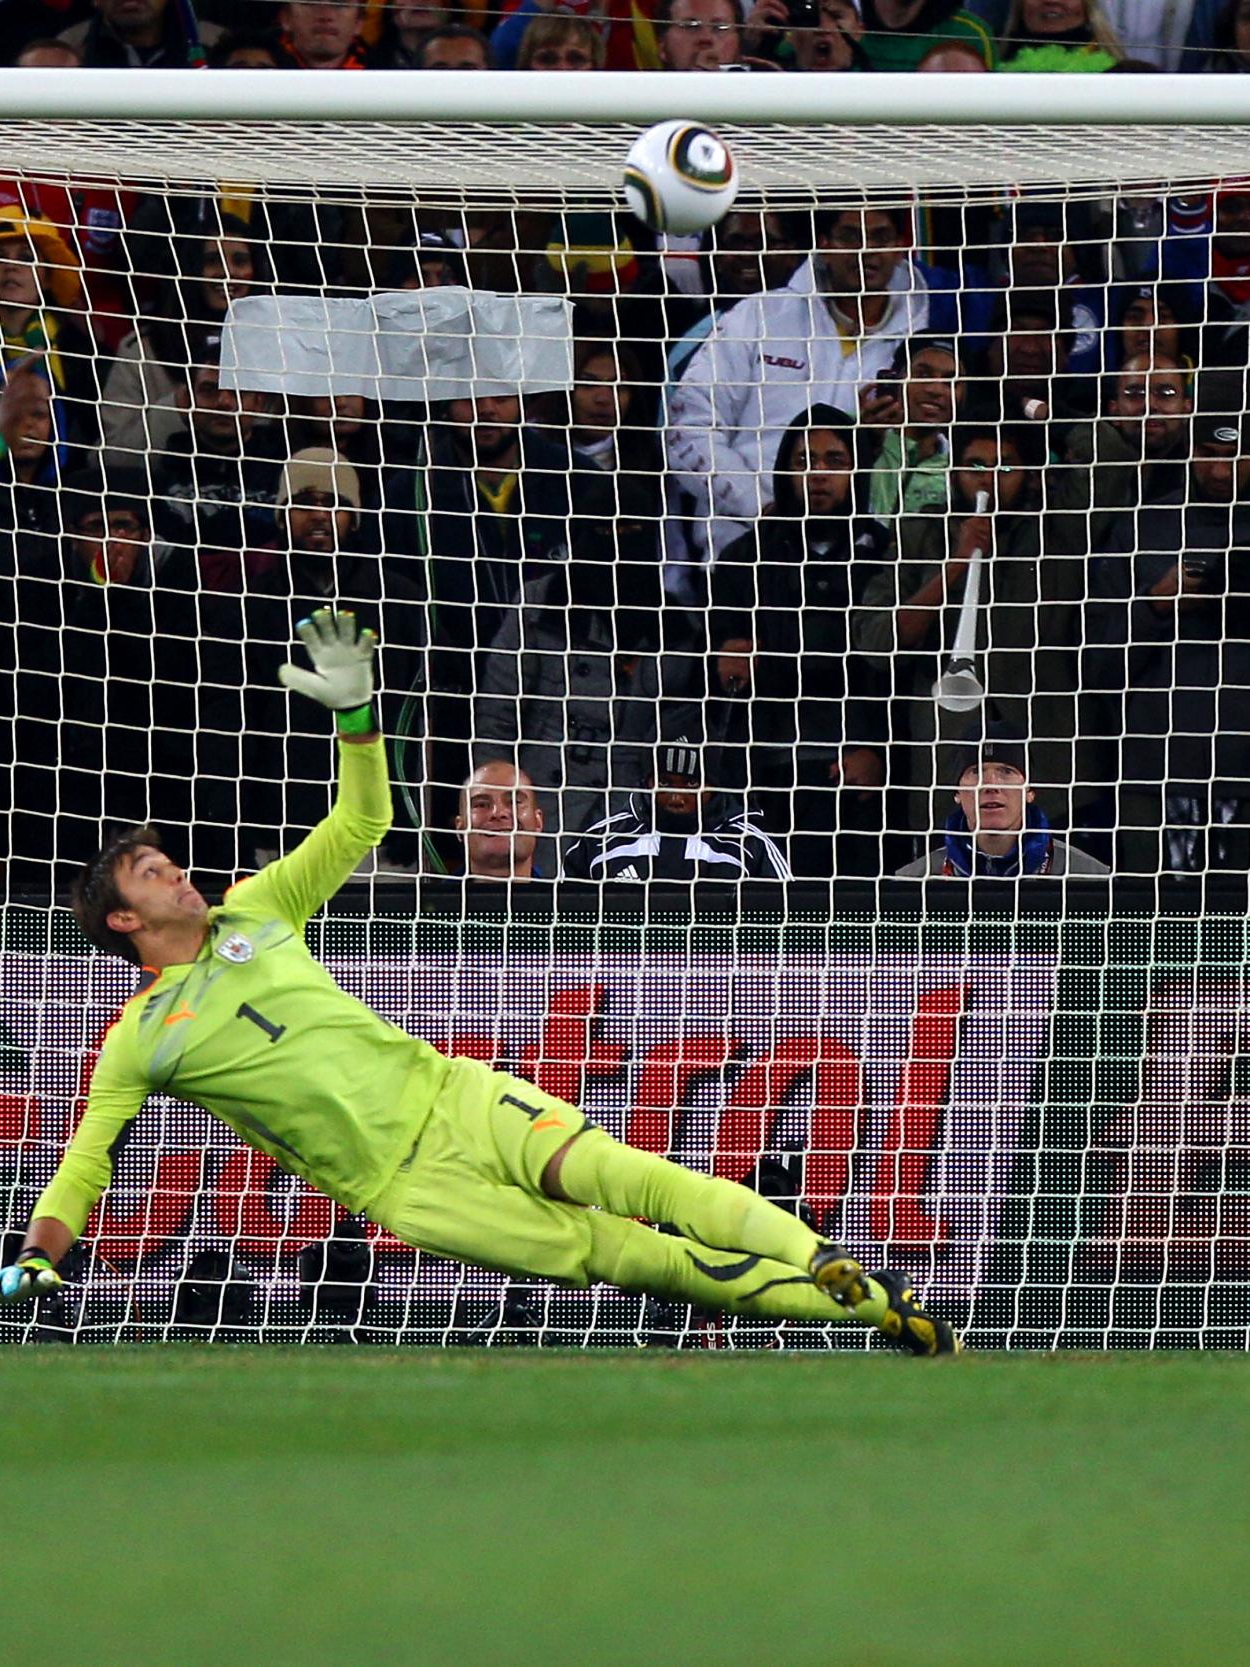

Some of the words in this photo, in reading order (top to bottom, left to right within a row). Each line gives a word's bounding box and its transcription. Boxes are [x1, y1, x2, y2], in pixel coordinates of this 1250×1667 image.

[236, 1002, 287, 1044] 1
[62, 983, 972, 1262] Catrol
[499, 1094, 545, 1121] 1
